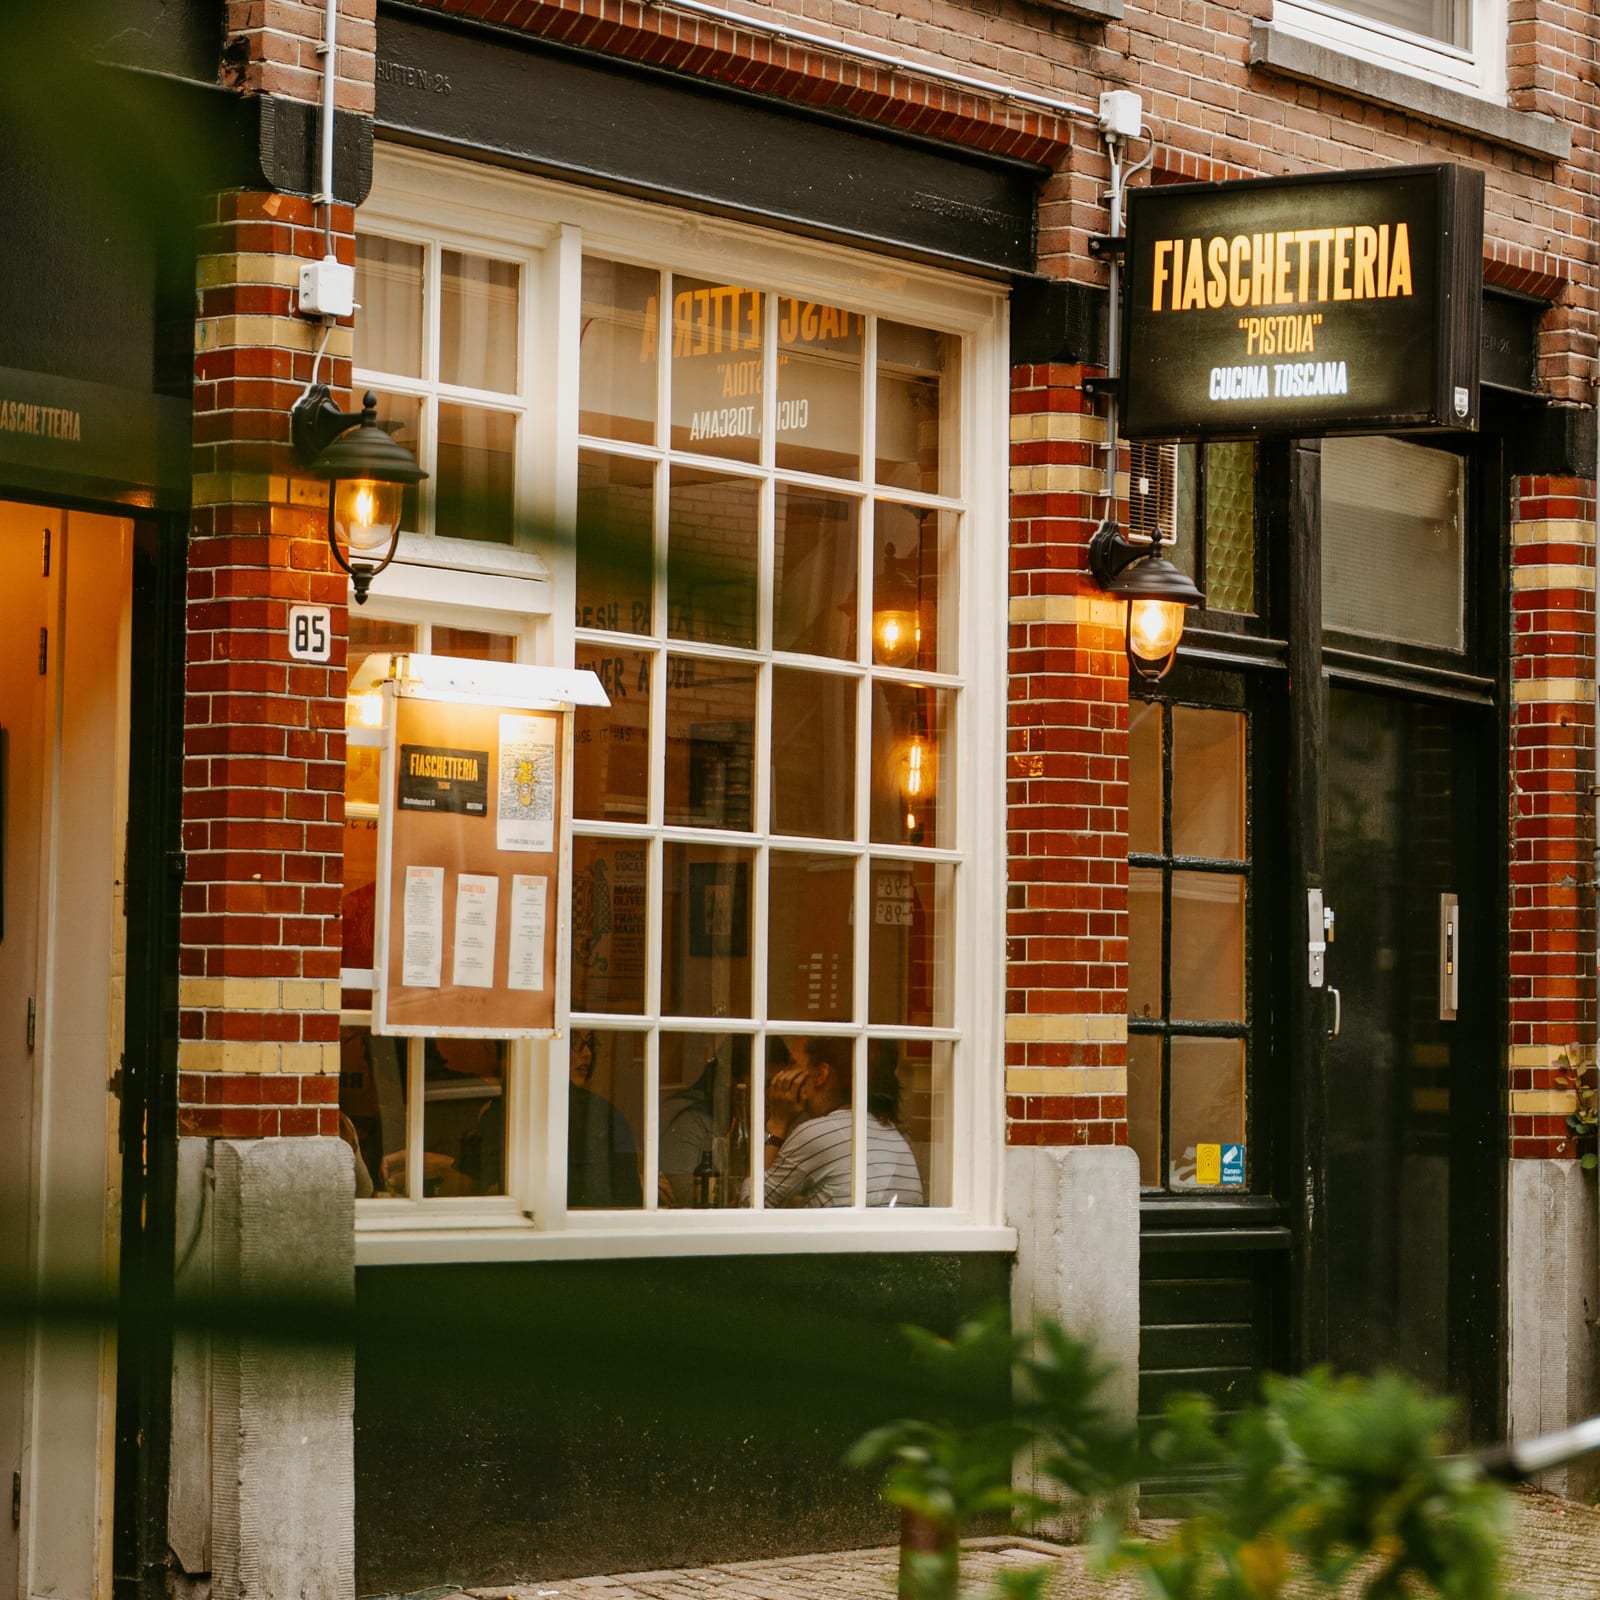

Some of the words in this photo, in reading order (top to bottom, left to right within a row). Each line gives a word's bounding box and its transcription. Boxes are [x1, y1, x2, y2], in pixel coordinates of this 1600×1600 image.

[1152, 223, 1413, 311] FIASCHETTERIA
[1209, 366, 1269, 400] CUCINA
[1274, 361, 1348, 397] TOSCANA
[0, 400, 80, 441] ASCHETTERIA
[296, 615, 324, 652] 85
[409, 753, 479, 782] FIASCHETTERIA
